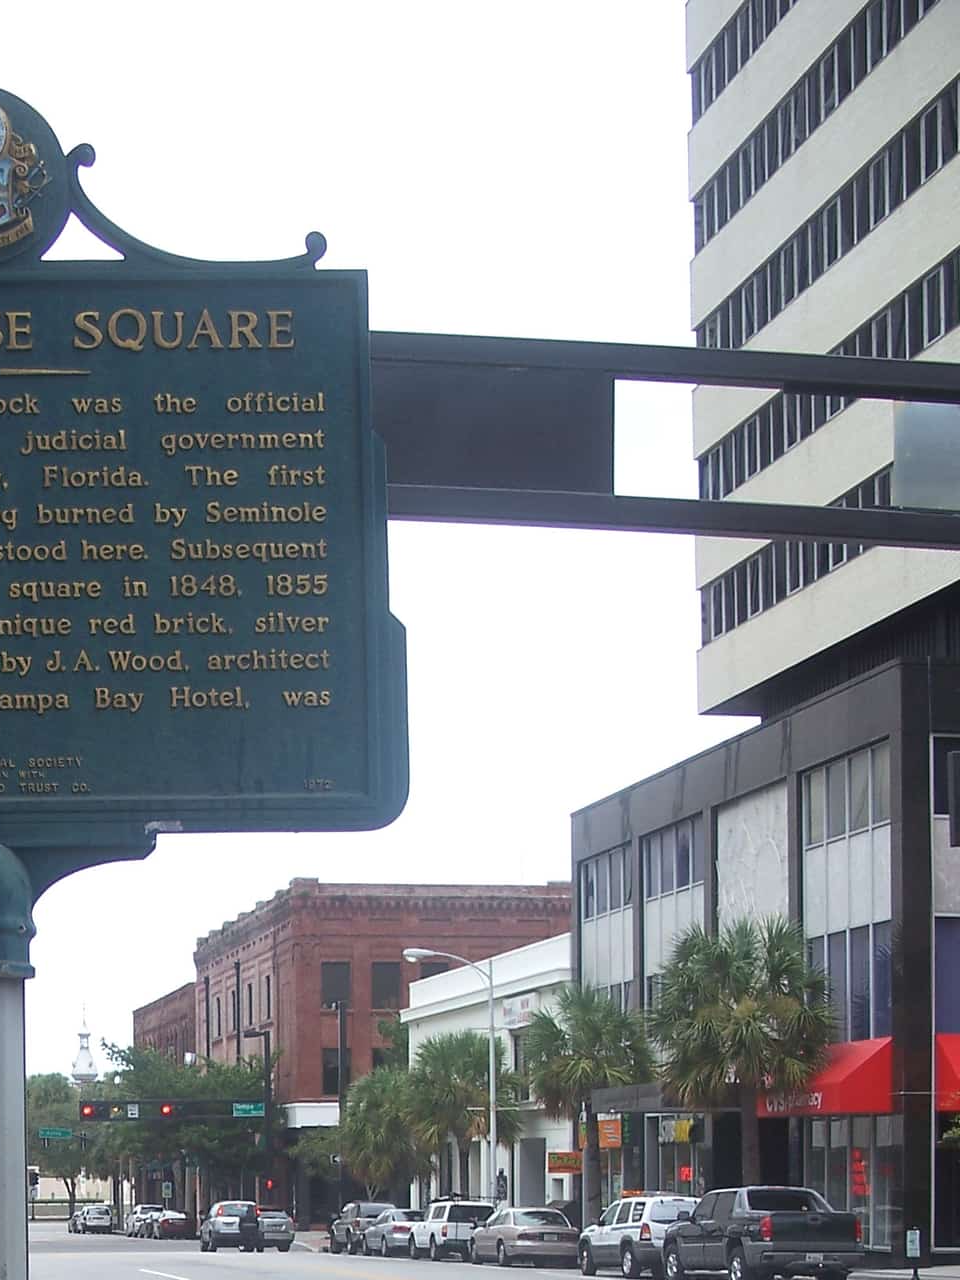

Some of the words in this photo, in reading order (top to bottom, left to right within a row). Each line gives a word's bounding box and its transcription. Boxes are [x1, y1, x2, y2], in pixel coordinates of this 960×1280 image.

[73, 308, 296, 350] SQUARE
[72, 396, 122, 414] was
[154, 393, 197, 413] the
[226, 392, 326, 412] official
[21, 430, 128, 456] judicial
[161, 429, 325, 456] government
[42, 466, 149, 489] Florida.
[185, 465, 239, 487] The
[267, 464, 326, 486] first
[37, 503, 135, 525] burned
[154, 503, 187, 528] by
[206, 502, 327, 523] Seminole
[81, 539, 149, 561] here.
[170, 537, 328, 565] Subsequent
[9, 579, 102, 602] square
[123, 576, 148, 598] in
[169, 574, 242, 597] 1848,
[267, 573, 329, 596] 1855
[89, 614, 136, 635] red
[154, 612, 233, 635] brick,
[255, 611, 330, 633] silver
[1, 651, 32, 676] by
[46, 650, 66, 672] J.
[73, 650, 100, 672] A.
[108, 650, 190, 673] Wood,
[207, 648, 330, 670] architect
[95, 687, 144, 712] Bay
[170, 686, 250, 708] Hotel,
[281, 688, 331, 707] was
[28, 756, 84, 768] SOCIETY
[19, 782, 60, 793] TRUST
[71, 782, 92, 793] CO.
